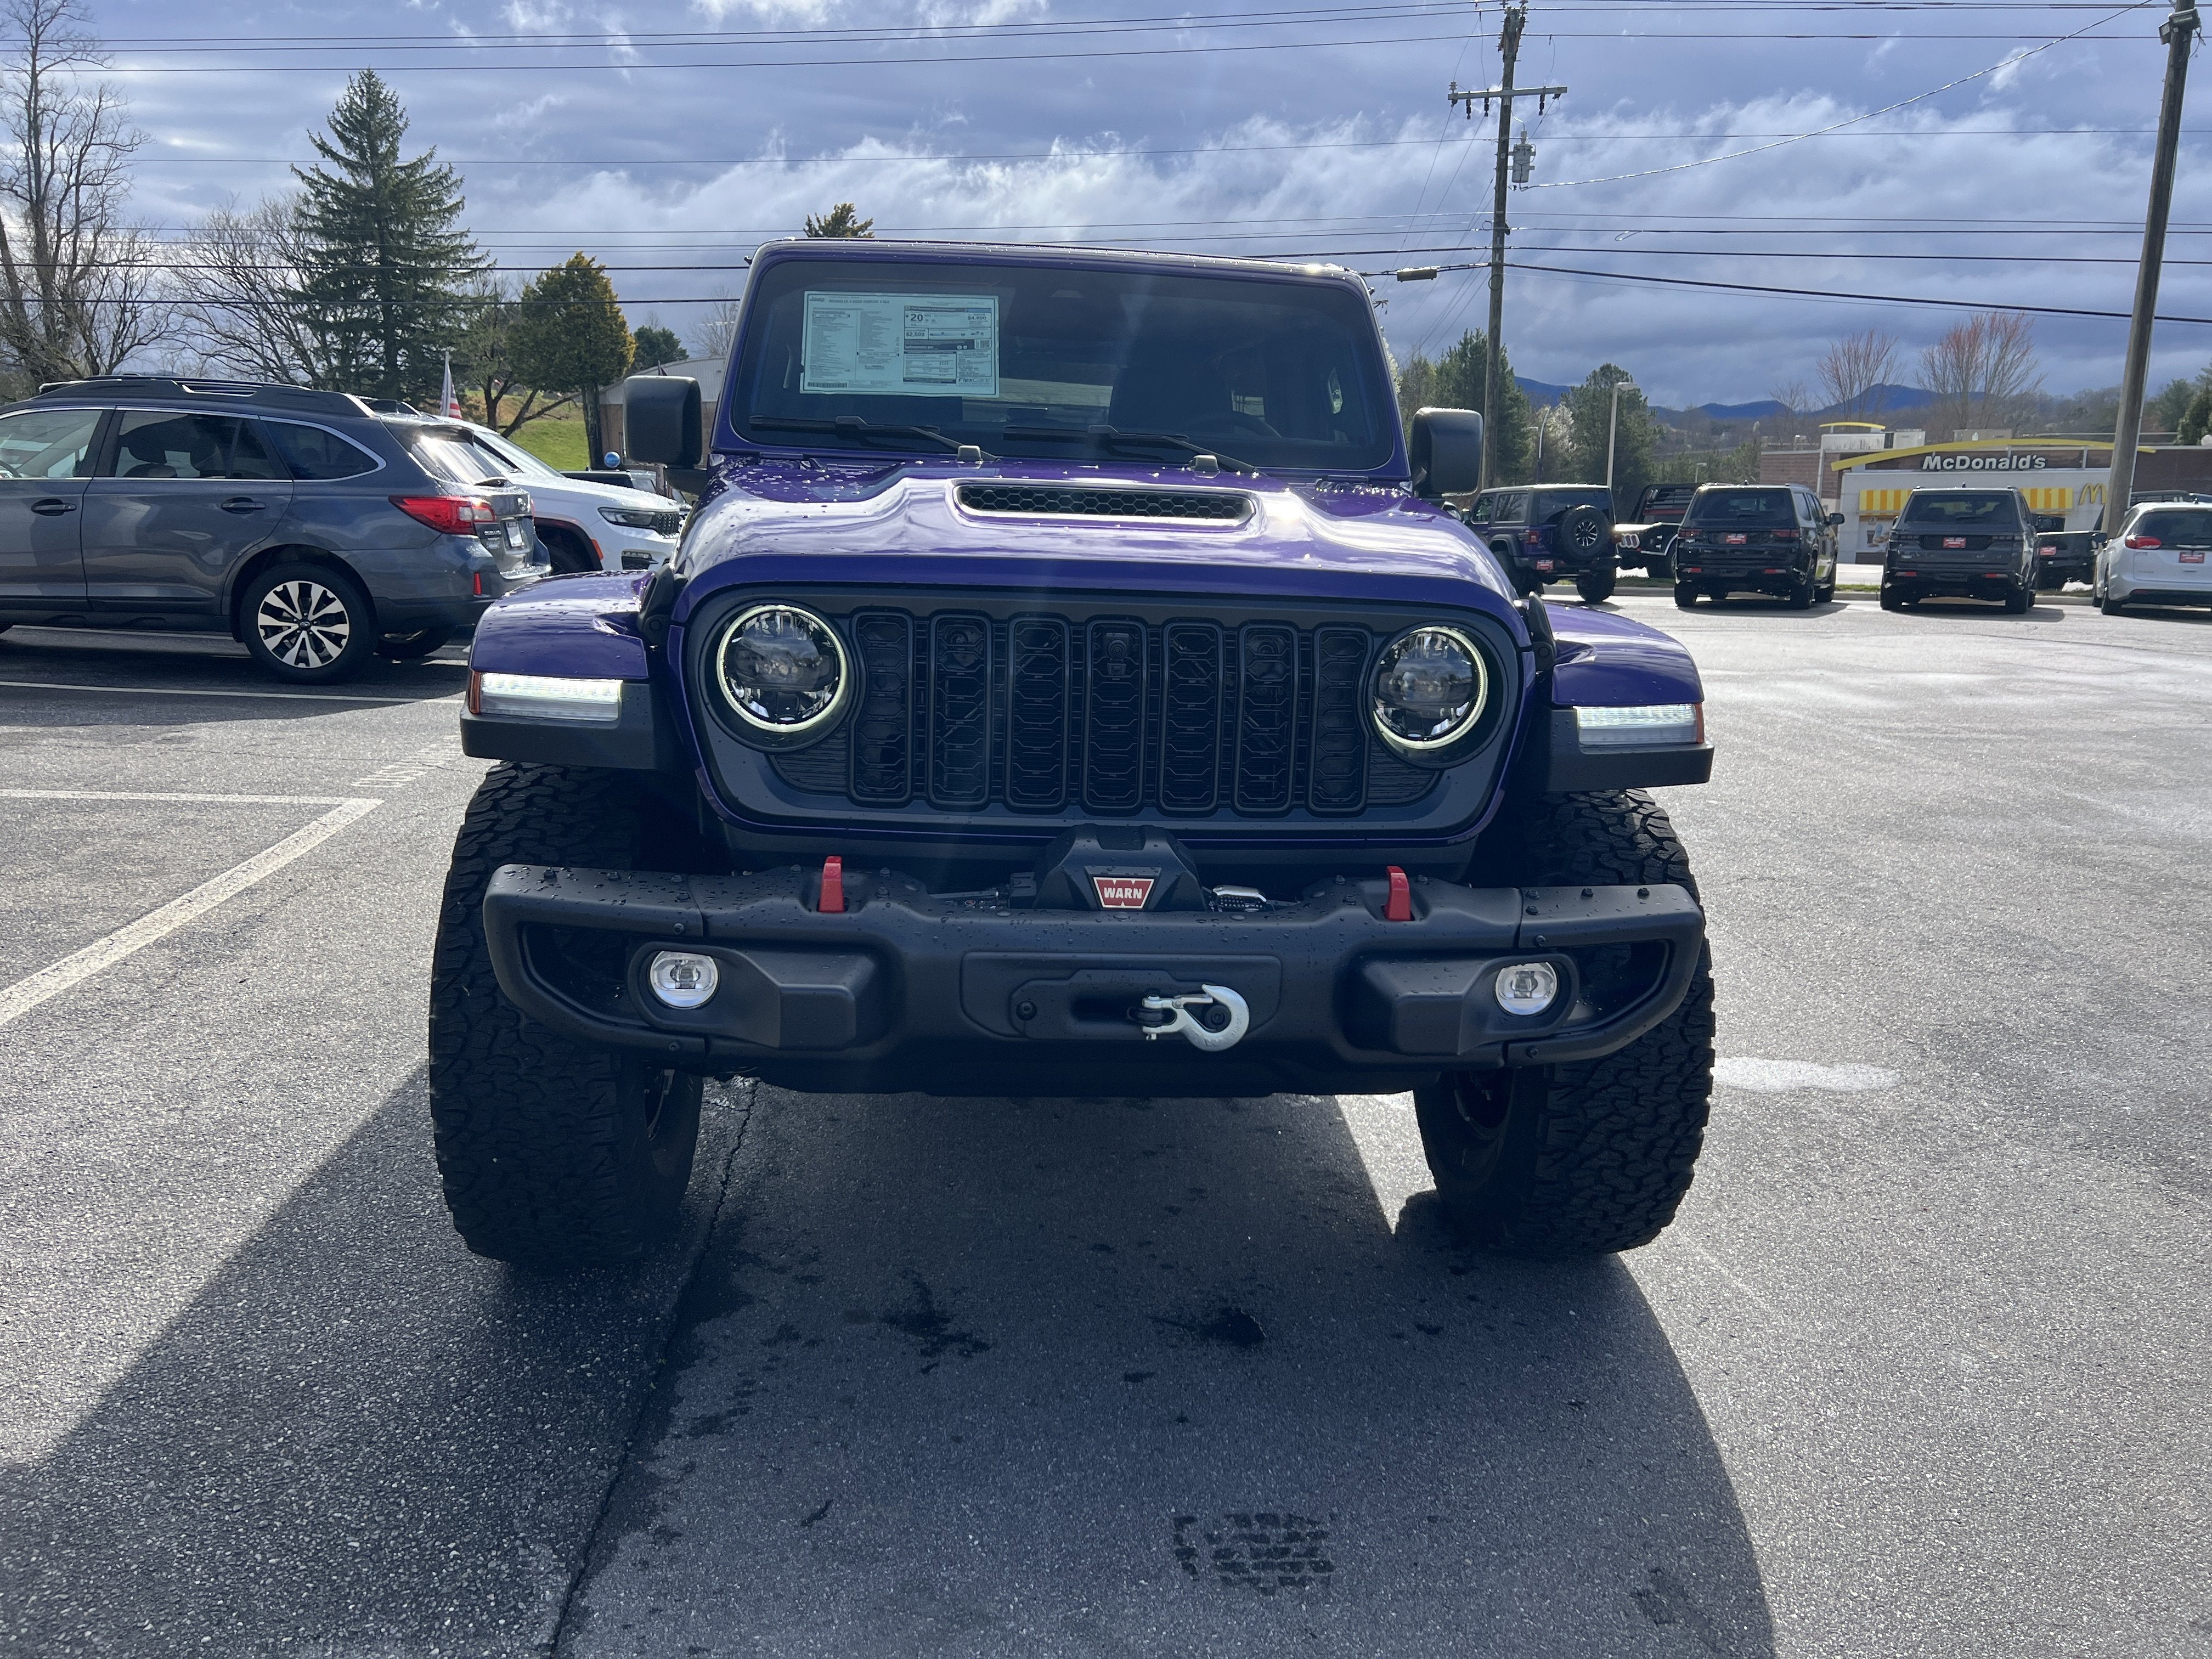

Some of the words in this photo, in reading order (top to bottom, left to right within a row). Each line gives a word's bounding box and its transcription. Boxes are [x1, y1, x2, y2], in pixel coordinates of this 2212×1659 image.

[910, 313, 923, 321] 20
[1922, 455, 2046, 470] McDonald's
[1104, 887, 1142, 899] WARN
